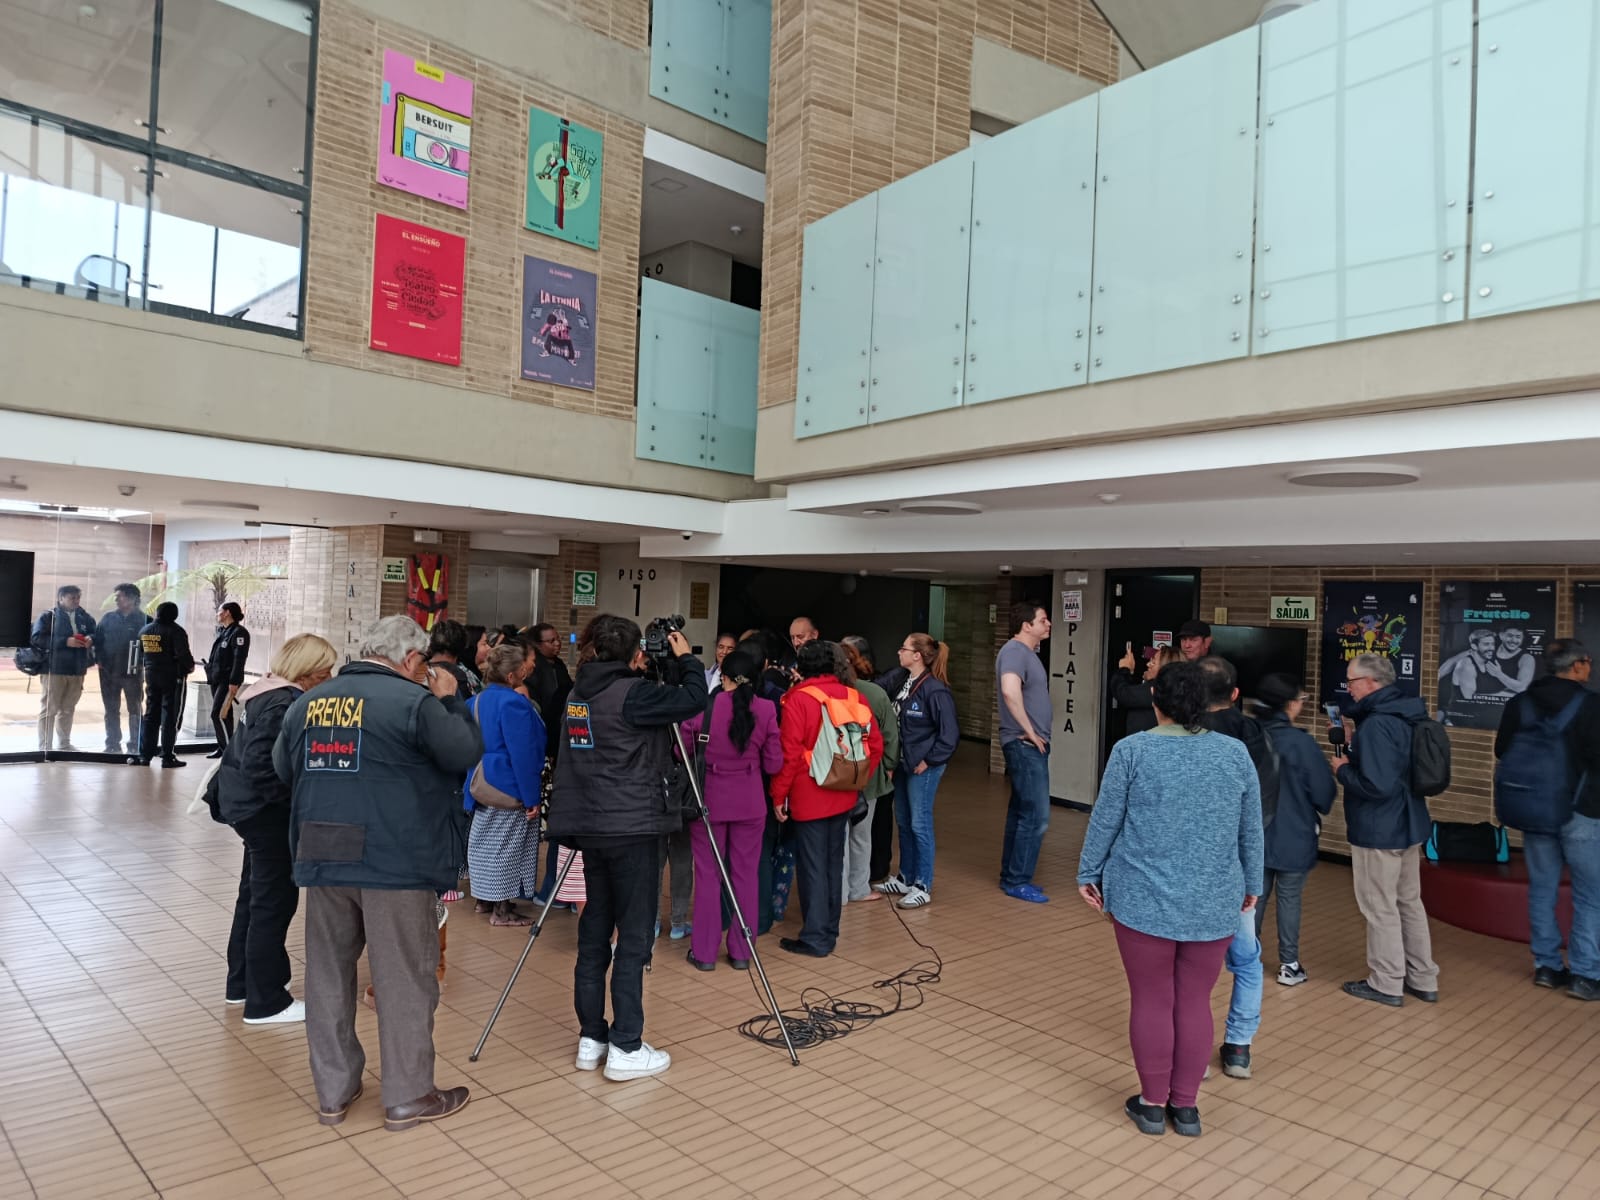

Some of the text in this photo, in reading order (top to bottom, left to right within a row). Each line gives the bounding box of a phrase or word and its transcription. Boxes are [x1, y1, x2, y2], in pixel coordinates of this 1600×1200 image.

[415, 112, 453, 133] BERSUIT
[402, 231, 410, 240] EL
[540, 289, 551, 305] LA
[577, 573, 593, 593] S
[618, 569, 656, 580] PISO
[632, 584, 641, 616] 1
[1276, 607, 1310, 619] SALIDA
[1531, 635, 1541, 645] 7
[1063, 622, 1078, 734] PLATEA
[304, 697, 364, 729] PRENSA
